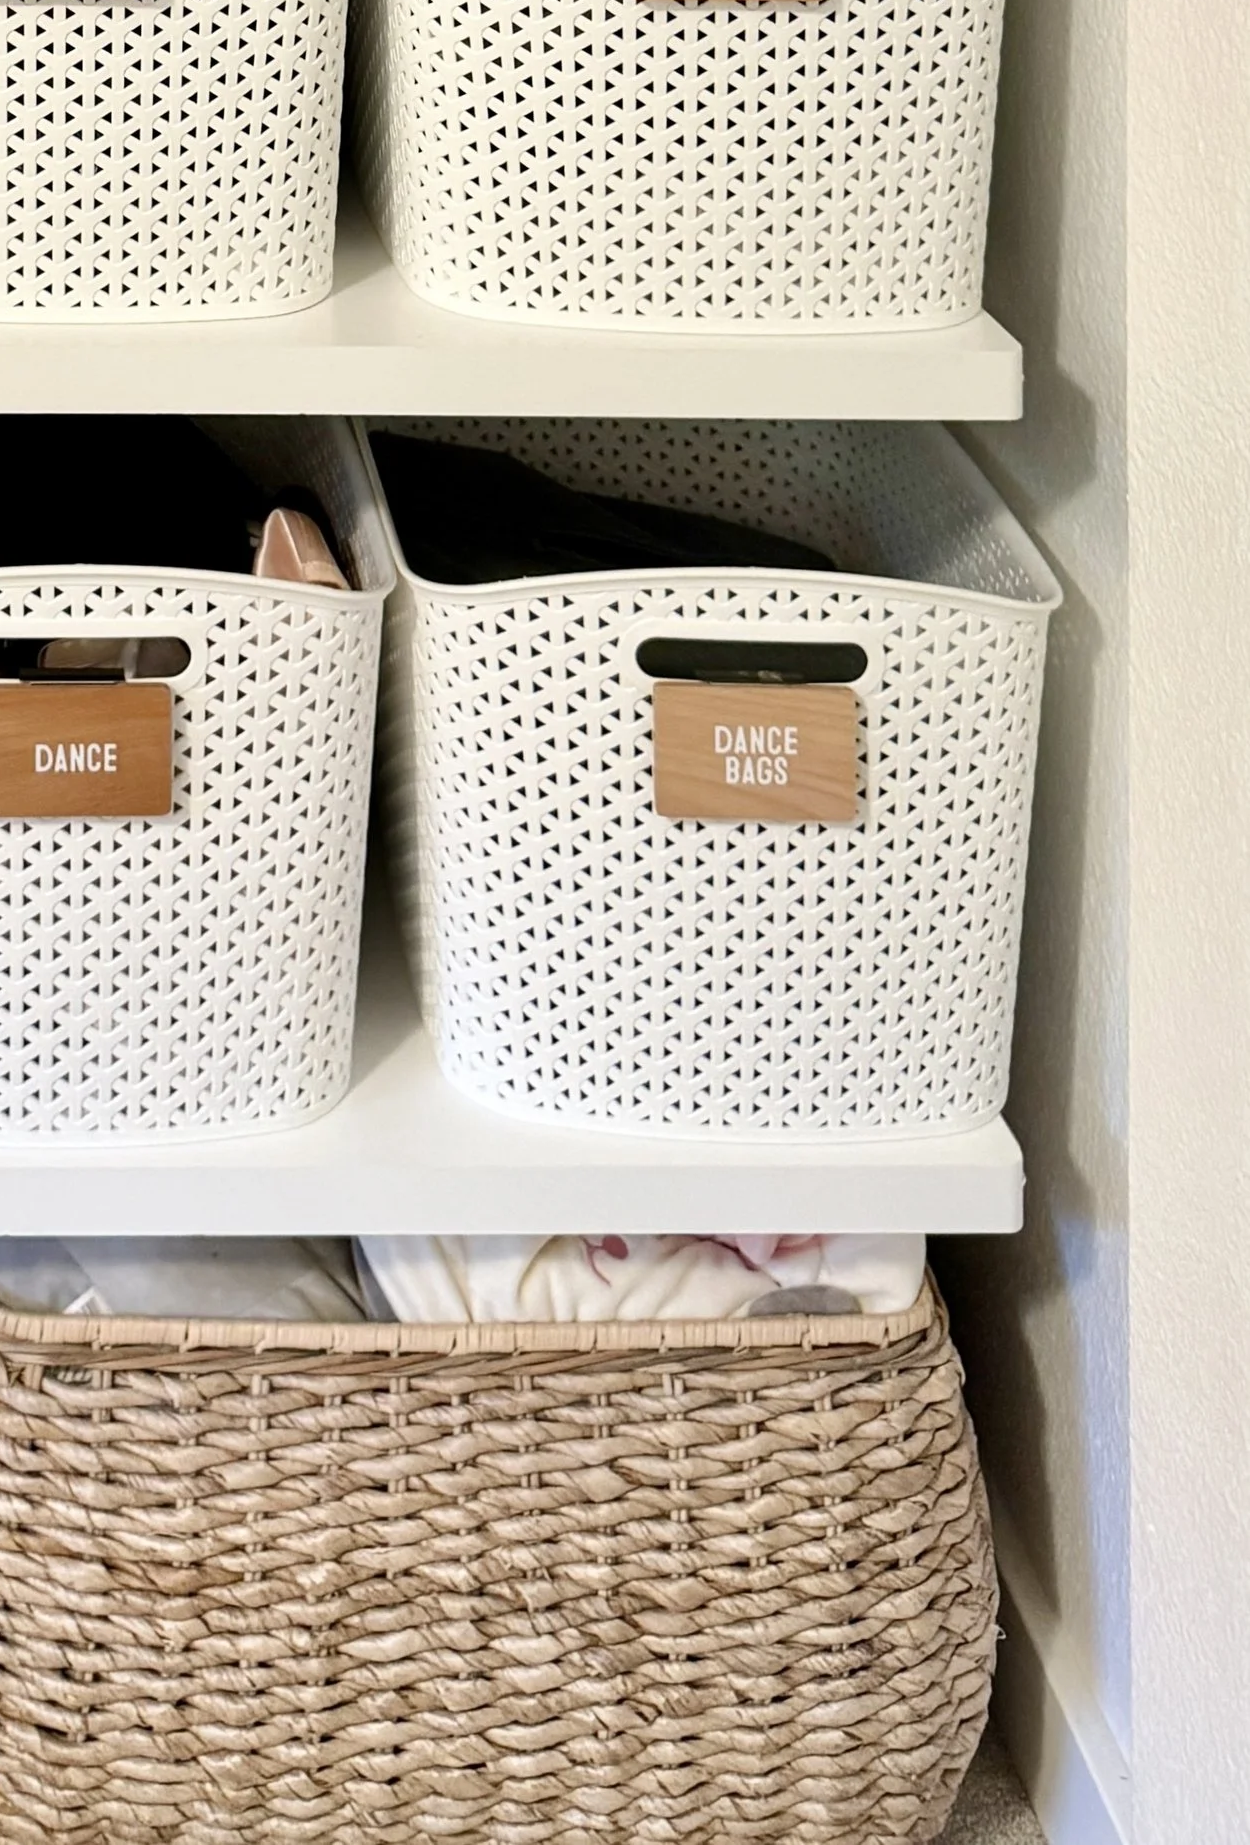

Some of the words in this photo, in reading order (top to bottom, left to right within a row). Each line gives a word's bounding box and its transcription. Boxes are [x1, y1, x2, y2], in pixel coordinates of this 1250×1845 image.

[714, 725, 798, 755] DANCE
[35, 743, 117, 773] DANCE
[725, 756, 788, 785] BAGS
